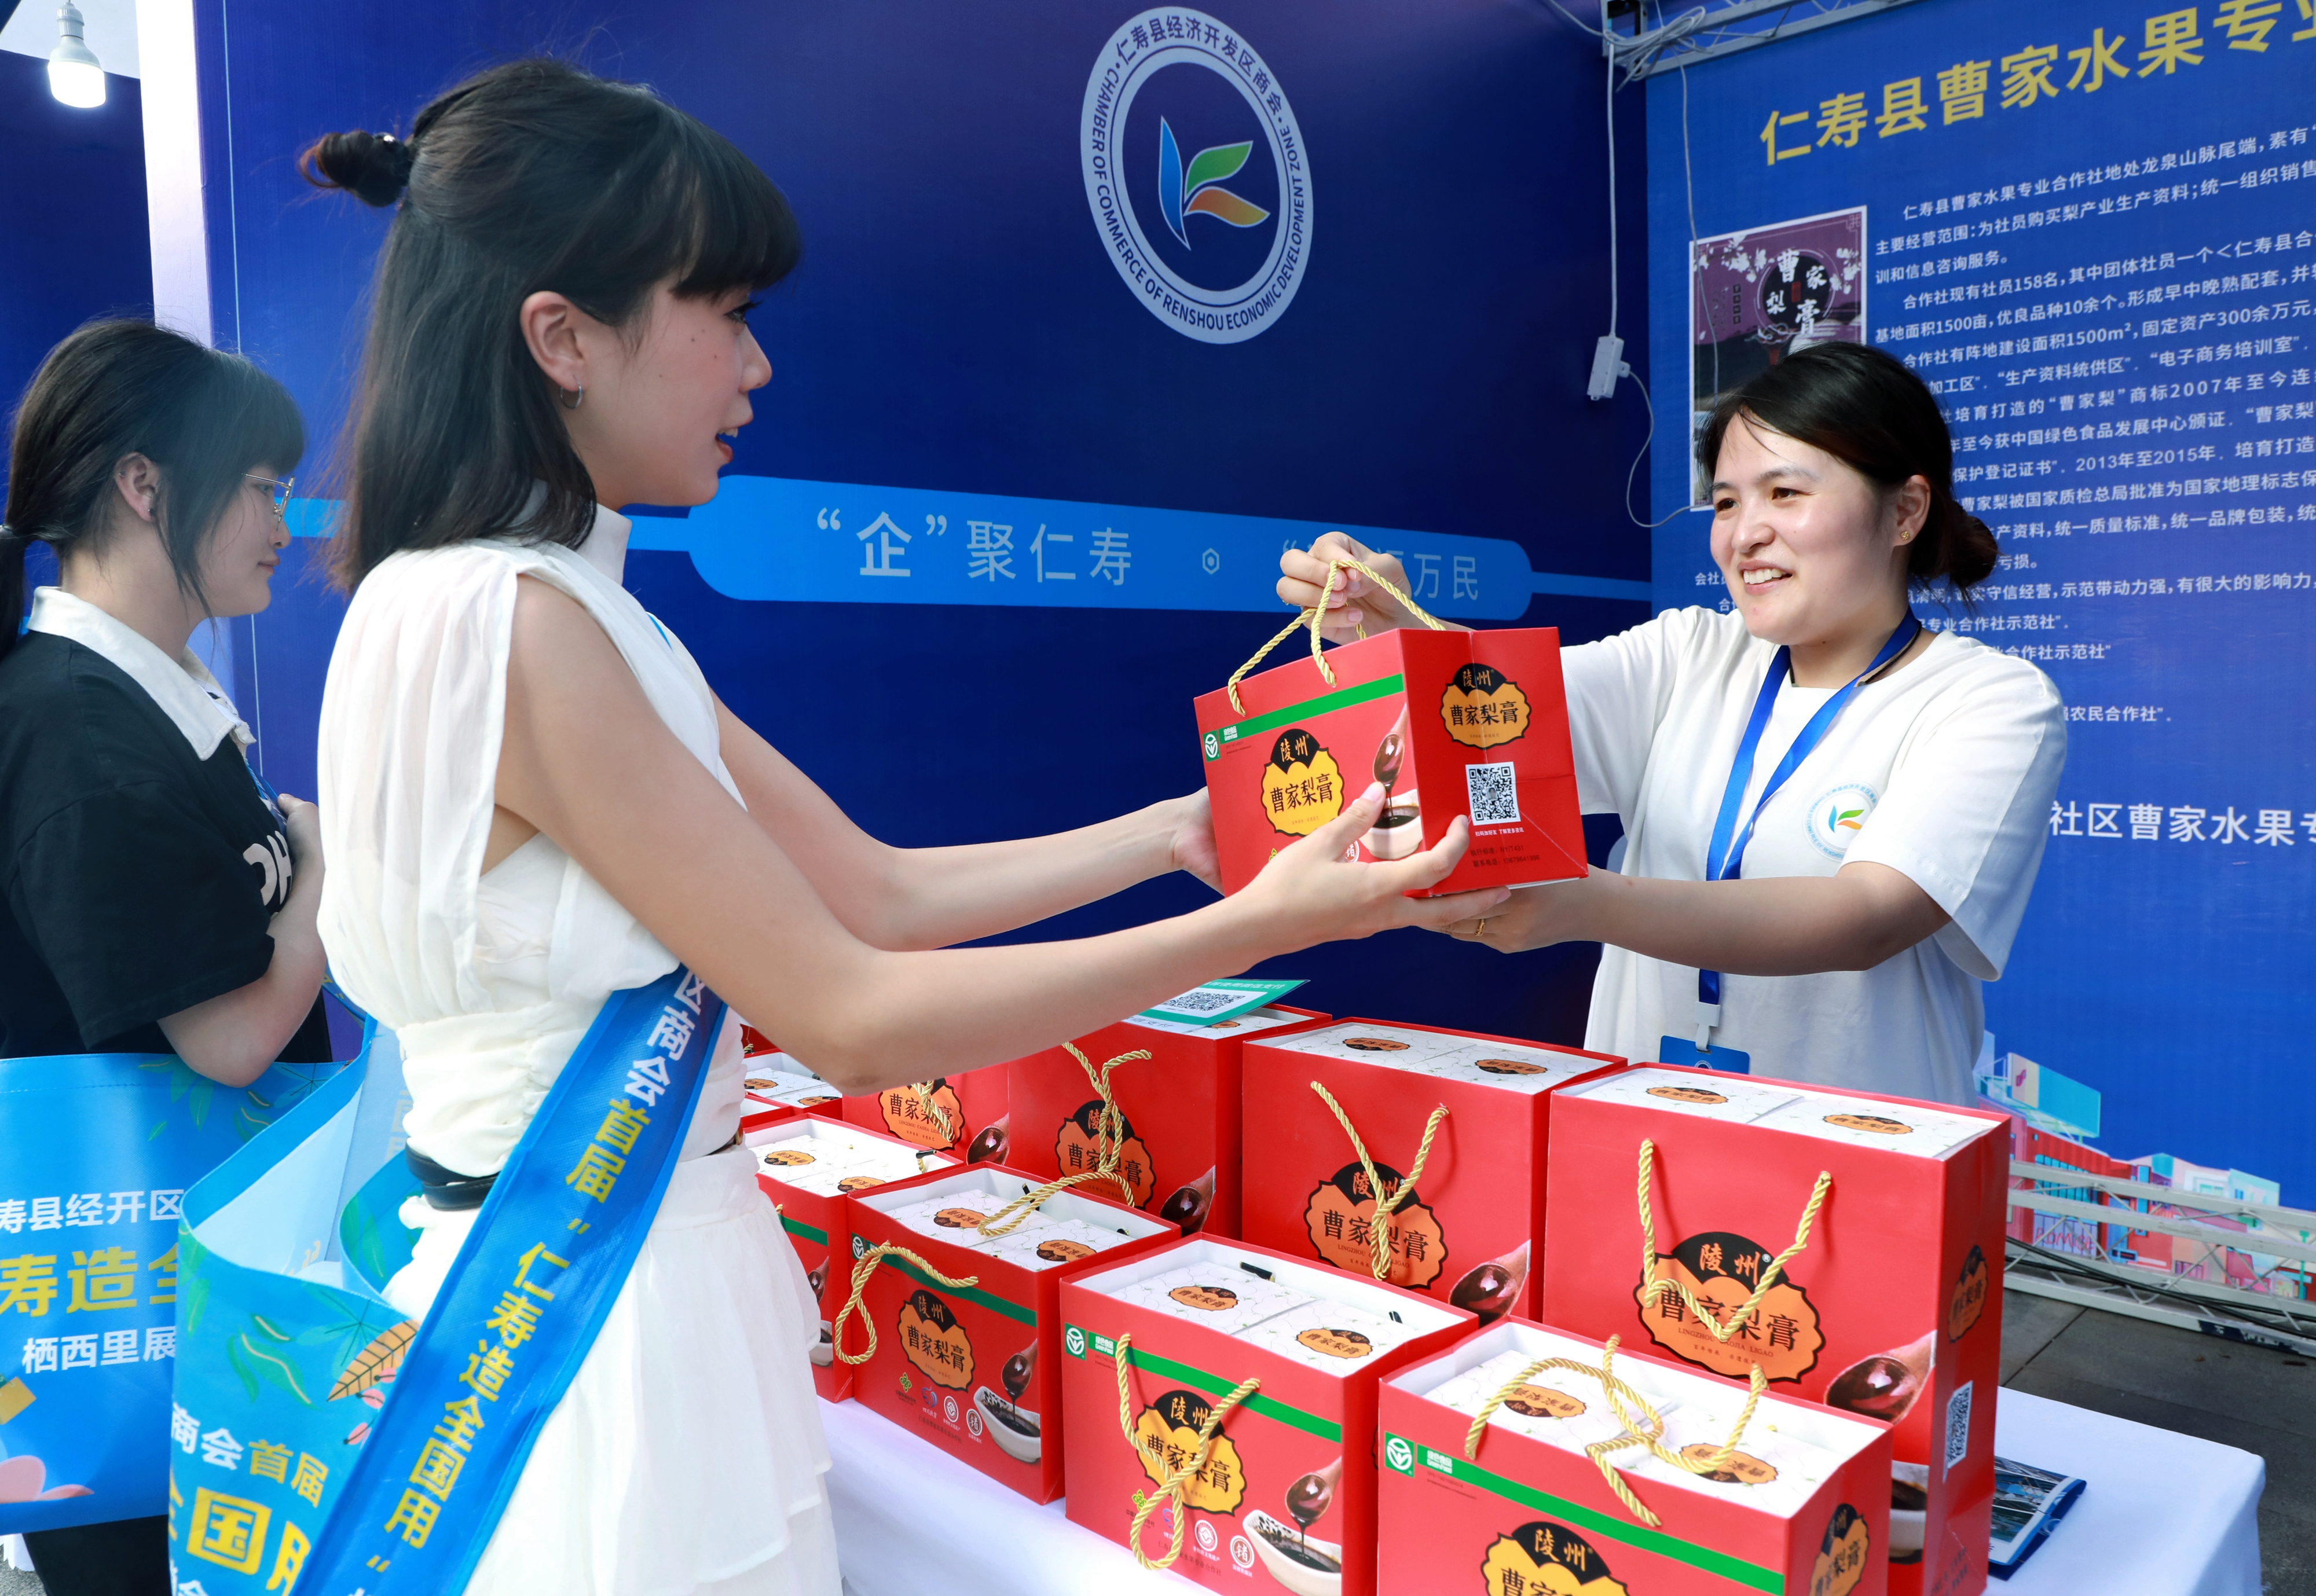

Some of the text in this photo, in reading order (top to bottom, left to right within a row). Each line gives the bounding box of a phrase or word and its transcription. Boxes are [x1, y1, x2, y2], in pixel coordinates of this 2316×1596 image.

[1116, 15, 1283, 116] 仁寿县经济开发区商会
[1092, 67, 1304, 331] CHAMBER OF COMMERCE OF RENSHOU ECONOMIC DEVELOPMENT ZONE
[1875, 250, 2007, 284] 训和信息咨询服务。
[1903, 230, 2316, 310] 合作社现有社员158名,其中团体社员一个<仁寿县合
[1875, 262, 2316, 343] 基地面积1500亩,优良品种10余个。形成早中晚熟配套,并
[1940, 367, 2316, 424] 社培育打造的“曹家梨”商标2007年至今连
[1990, 503, 2316, 540] 产资料,统一质量标准,统一品牌包装,统
[1462, 669, 1492, 689] 陵州
[1449, 700, 1519, 727] 曹家梨膏
[1280, 736, 1309, 762] 陵州
[1270, 773, 1333, 814] 曹家梨膏
[1126, 1016, 1174, 1028] 信支付
[0, 1189, 185, 1234] 寿县经开区
[1338, 1245, 1409, 1268] LINGZHOU LIGAO
[21, 1326, 176, 1374] 栖西里展
[907, 1325, 966, 1374] 曹家梨膏
[1679, 1327, 1774, 1357] LINGZHOU AOJIA LIGAO
[171, 1401, 329, 1509] 商会首届
[1534, 1528, 1587, 1572] 陵州
